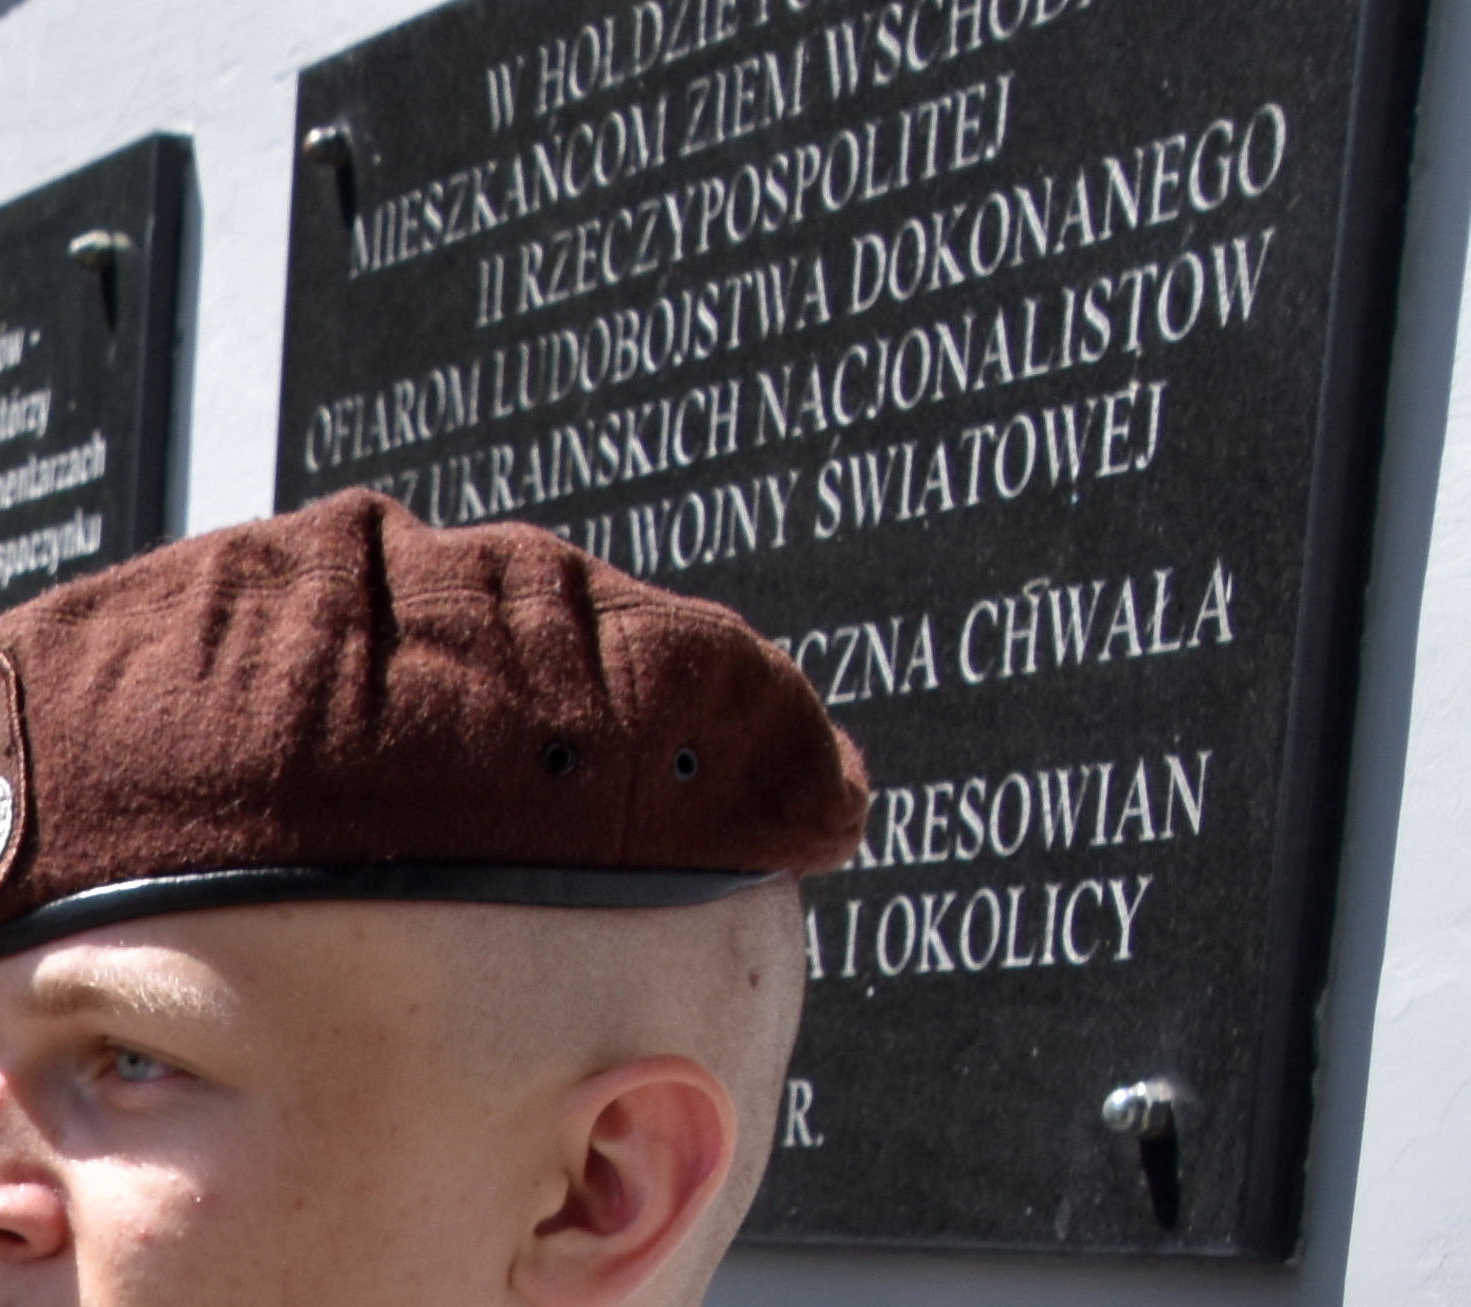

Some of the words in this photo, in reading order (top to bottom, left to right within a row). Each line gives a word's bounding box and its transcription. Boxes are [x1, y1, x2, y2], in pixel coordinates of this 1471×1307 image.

[349, 94, 667, 280] MIESZKAŃCOM
[679, 38, 809, 157] ZIEM
[488, 54, 524, 134] W
[304, 357, 481, 474] OFIAROM
[491, 254, 832, 420] LUDOBÓJSTWA
[848, 101, 1288, 317] DOKONANEGO
[477, 253, 505, 328] II
[515, 70, 1016, 314] RZECZYPOSPOLITEJ
[429, 377, 744, 529] UKRAIŃSKICH
[755, 225, 1277, 448] NACJONALISTÓW
[629, 471, 801, 577] WOJNY
[814, 380, 1168, 541] ŚWIATOWEJ
[959, 558, 1234, 685] CHWAŁA
[840, 750, 1213, 872] KRESOWIAN
[840, 899, 863, 979] I
[875, 873, 1154, 979] OKOLICY
